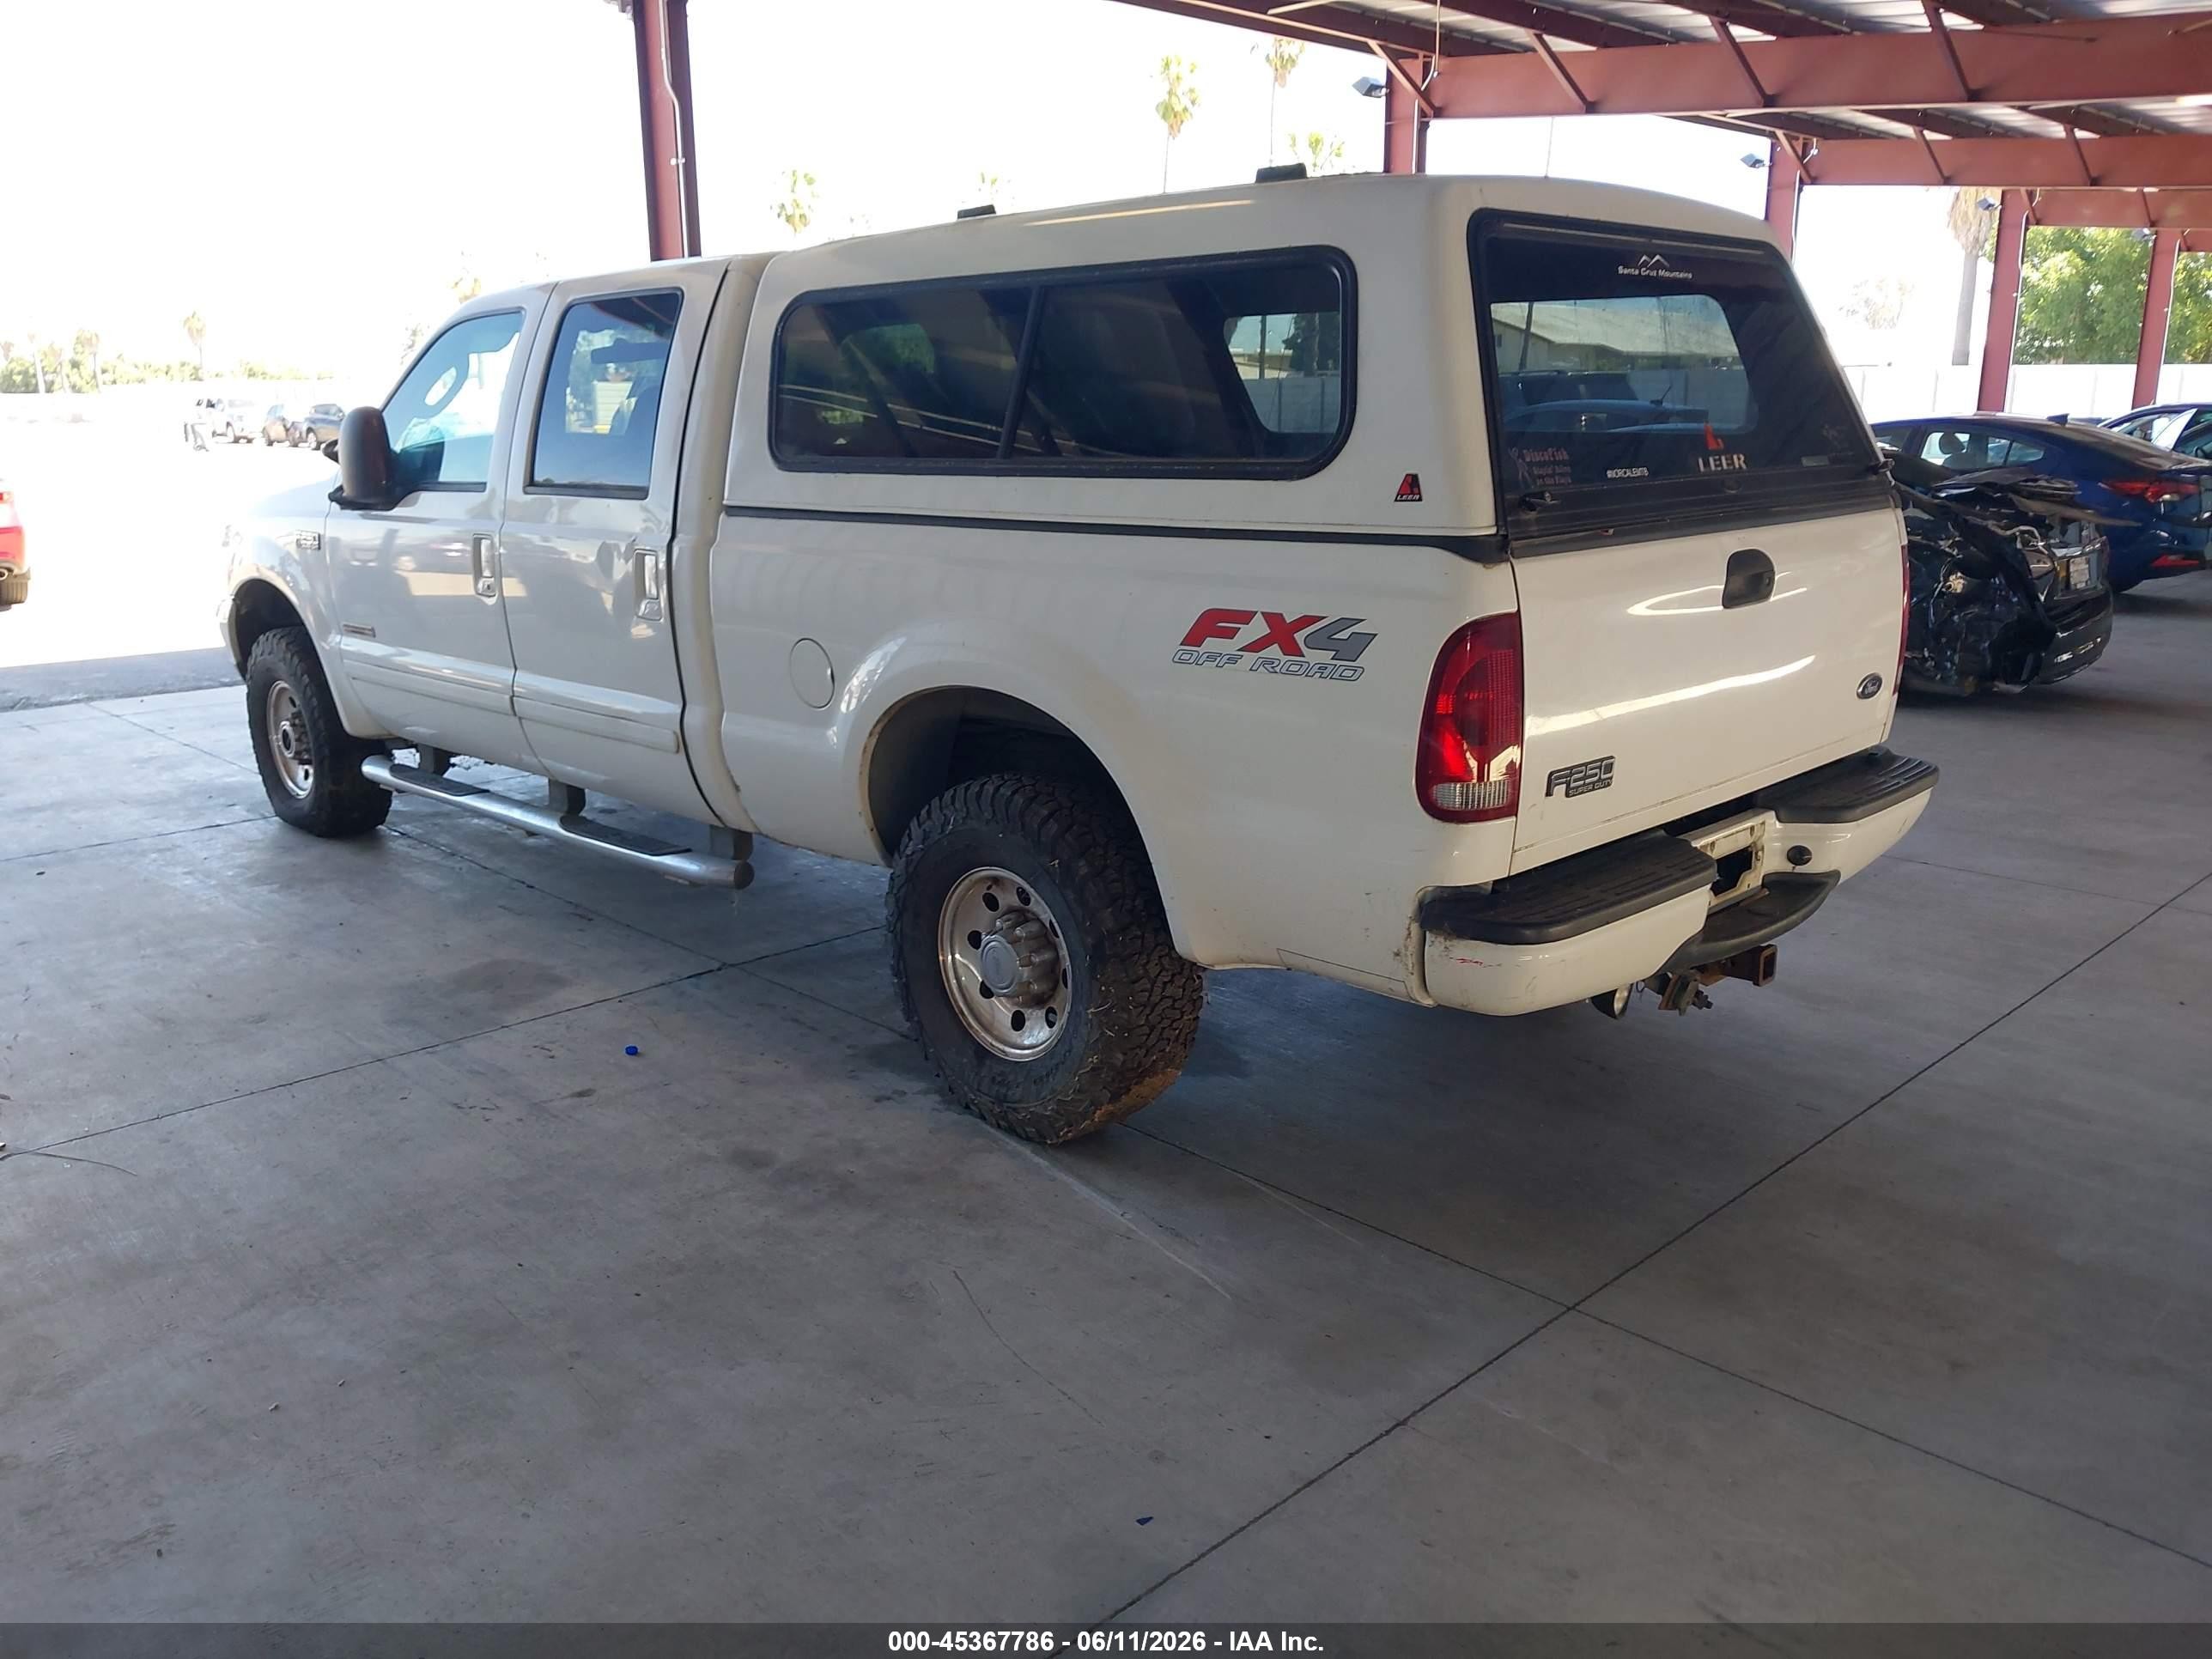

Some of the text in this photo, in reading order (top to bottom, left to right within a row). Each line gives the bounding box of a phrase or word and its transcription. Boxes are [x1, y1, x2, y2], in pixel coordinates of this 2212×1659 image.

[1618, 265, 1692, 279] Santa Cruz Mountains
[1698, 453, 1747, 472] LEER
[1178, 608, 1378, 663] FX4
[1172, 648, 1365, 682] OFF ROAD
[1550, 758, 1615, 797] F250
[1569, 779, 1613, 796] SUPER DUTY
